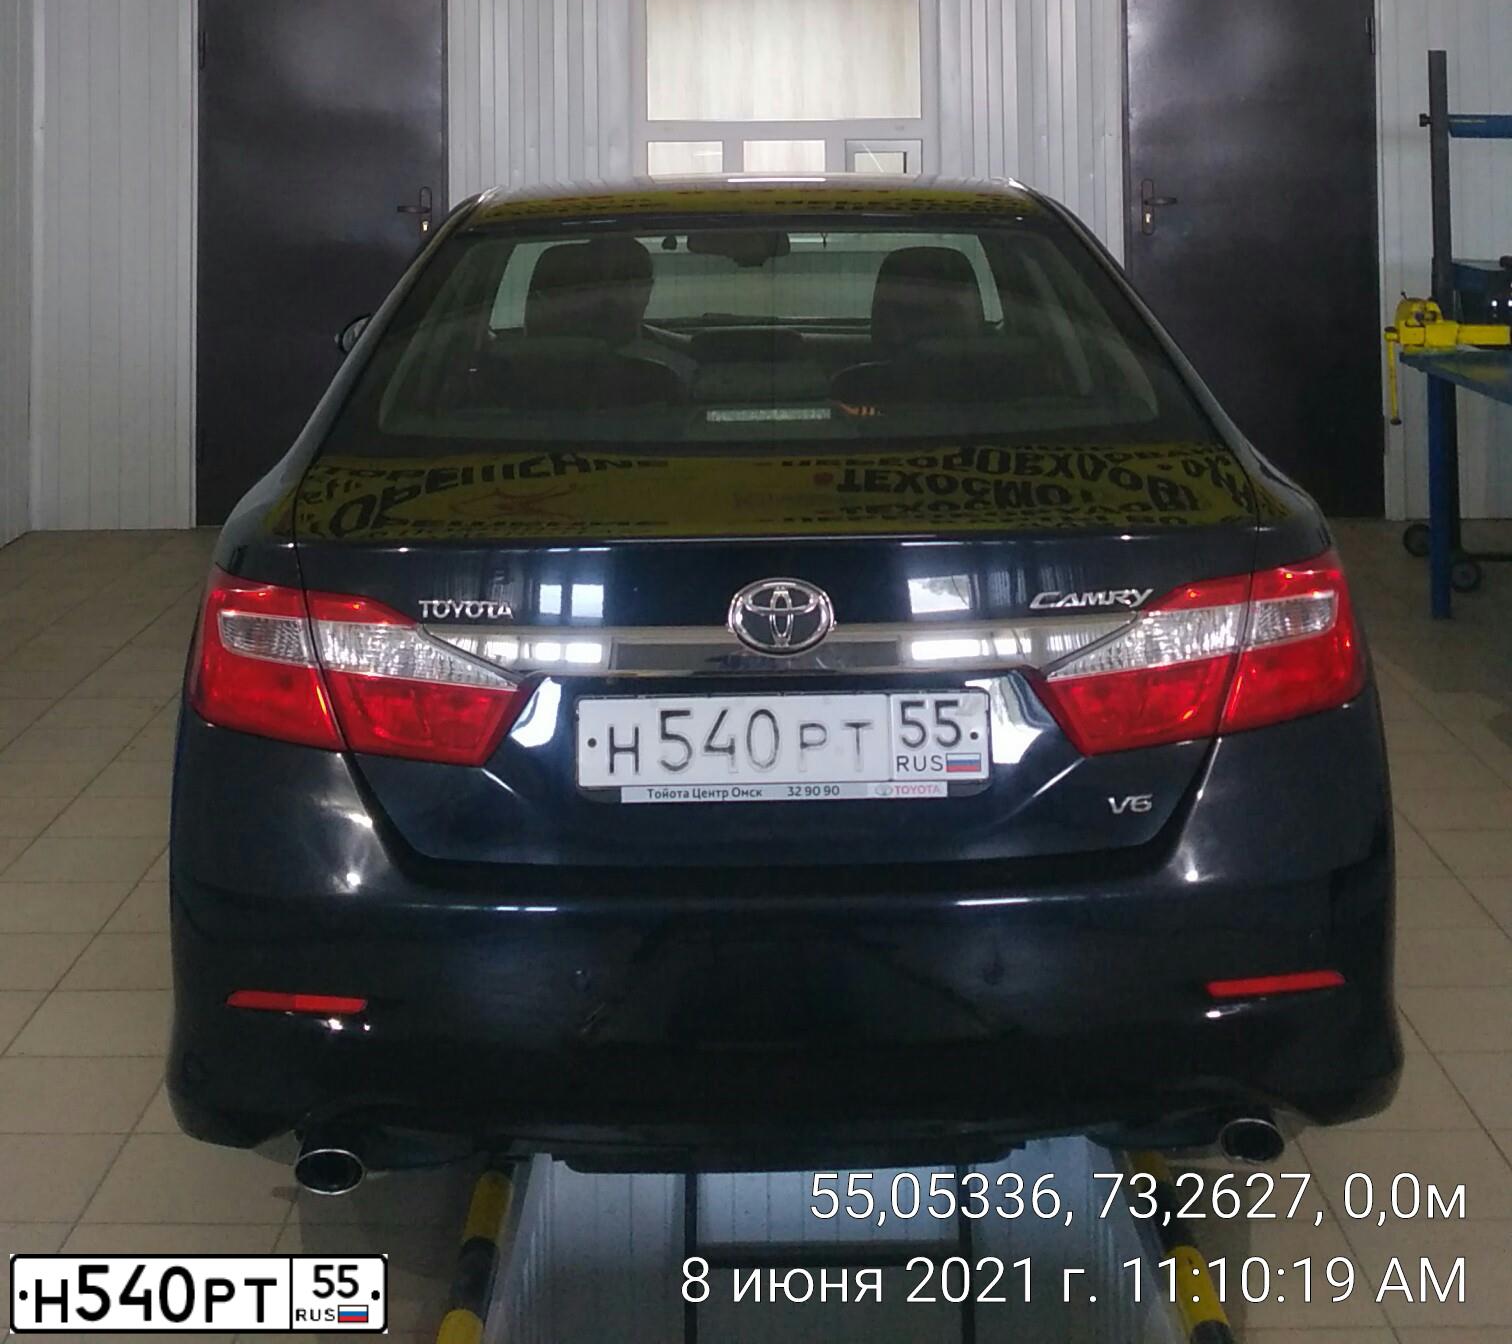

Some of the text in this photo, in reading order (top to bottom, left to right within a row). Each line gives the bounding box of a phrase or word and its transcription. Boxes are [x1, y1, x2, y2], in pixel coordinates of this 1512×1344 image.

[1029, 588, 1154, 610] CAMRY
[418, 600, 514, 620] TOYOTA
[899, 700, 962, 748] 55
[896, 755, 943, 772] RUS
[647, 786, 840, 802] Тойота Центр Омск 32 90 90
[893, 785, 942, 795] TOYOTA
[1108, 794, 1152, 814] V6
